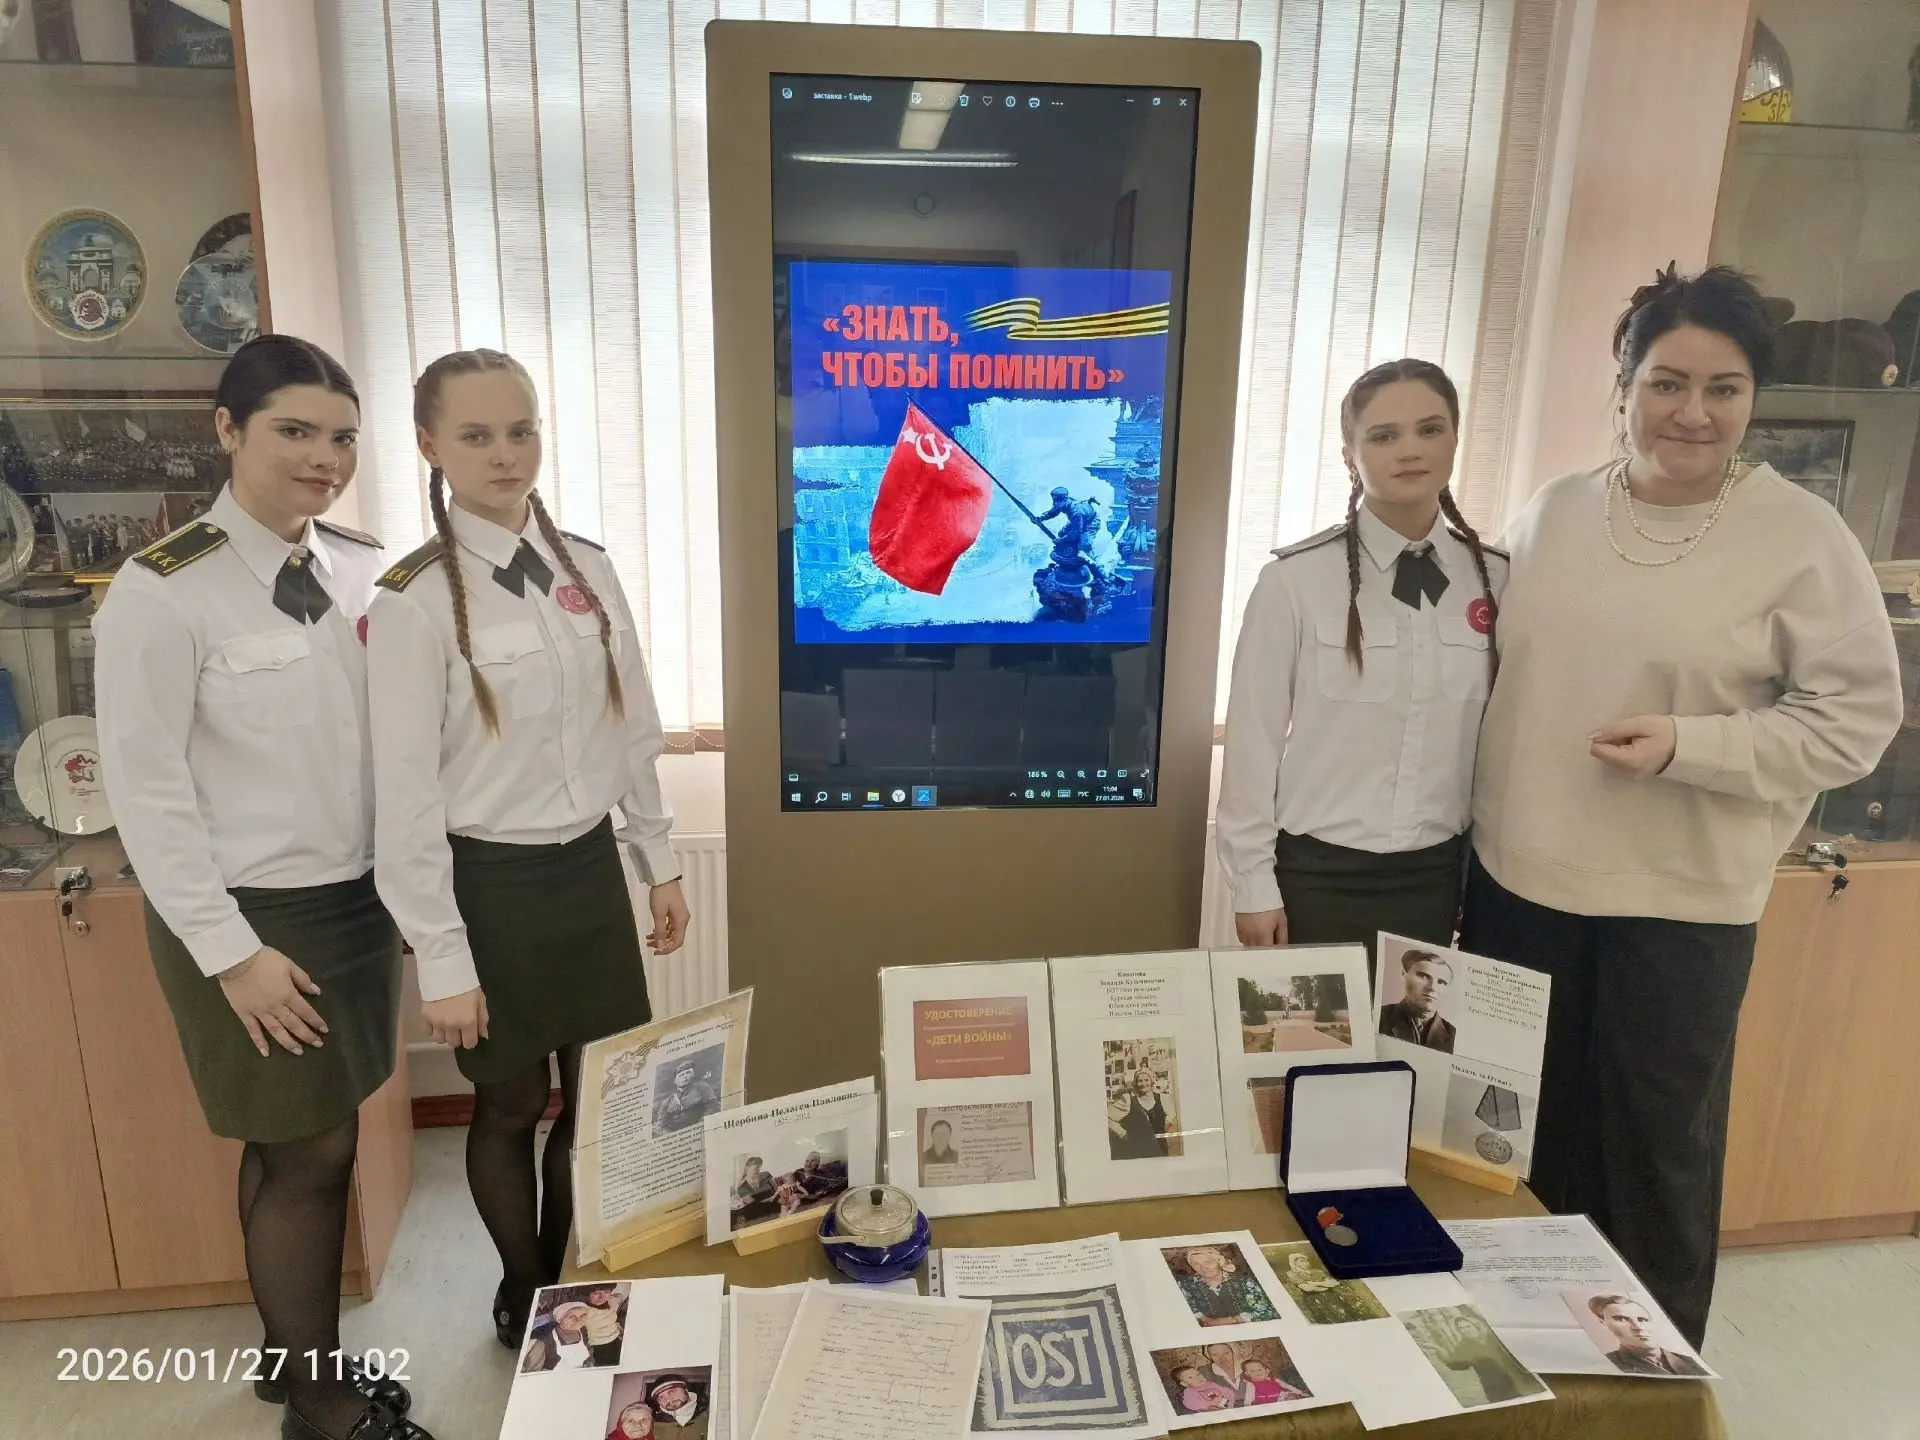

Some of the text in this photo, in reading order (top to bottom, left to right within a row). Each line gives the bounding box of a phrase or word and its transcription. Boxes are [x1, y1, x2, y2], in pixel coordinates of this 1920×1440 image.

[813, 93, 842, 101] заставка
[848, 92, 872, 103] 1.webp
[822, 304, 959, 347] «ЗНАТЬ,
[822, 351, 1125, 390] ЧТОБЫ ПОМНИТЬ»
[924, 1006, 1013, 1021] УДОСТОВЕРЕНИЕ
[926, 1030, 1012, 1046] «ДЕТИ ВОЙНЫ»
[1012, 1328, 1093, 1389] OST
